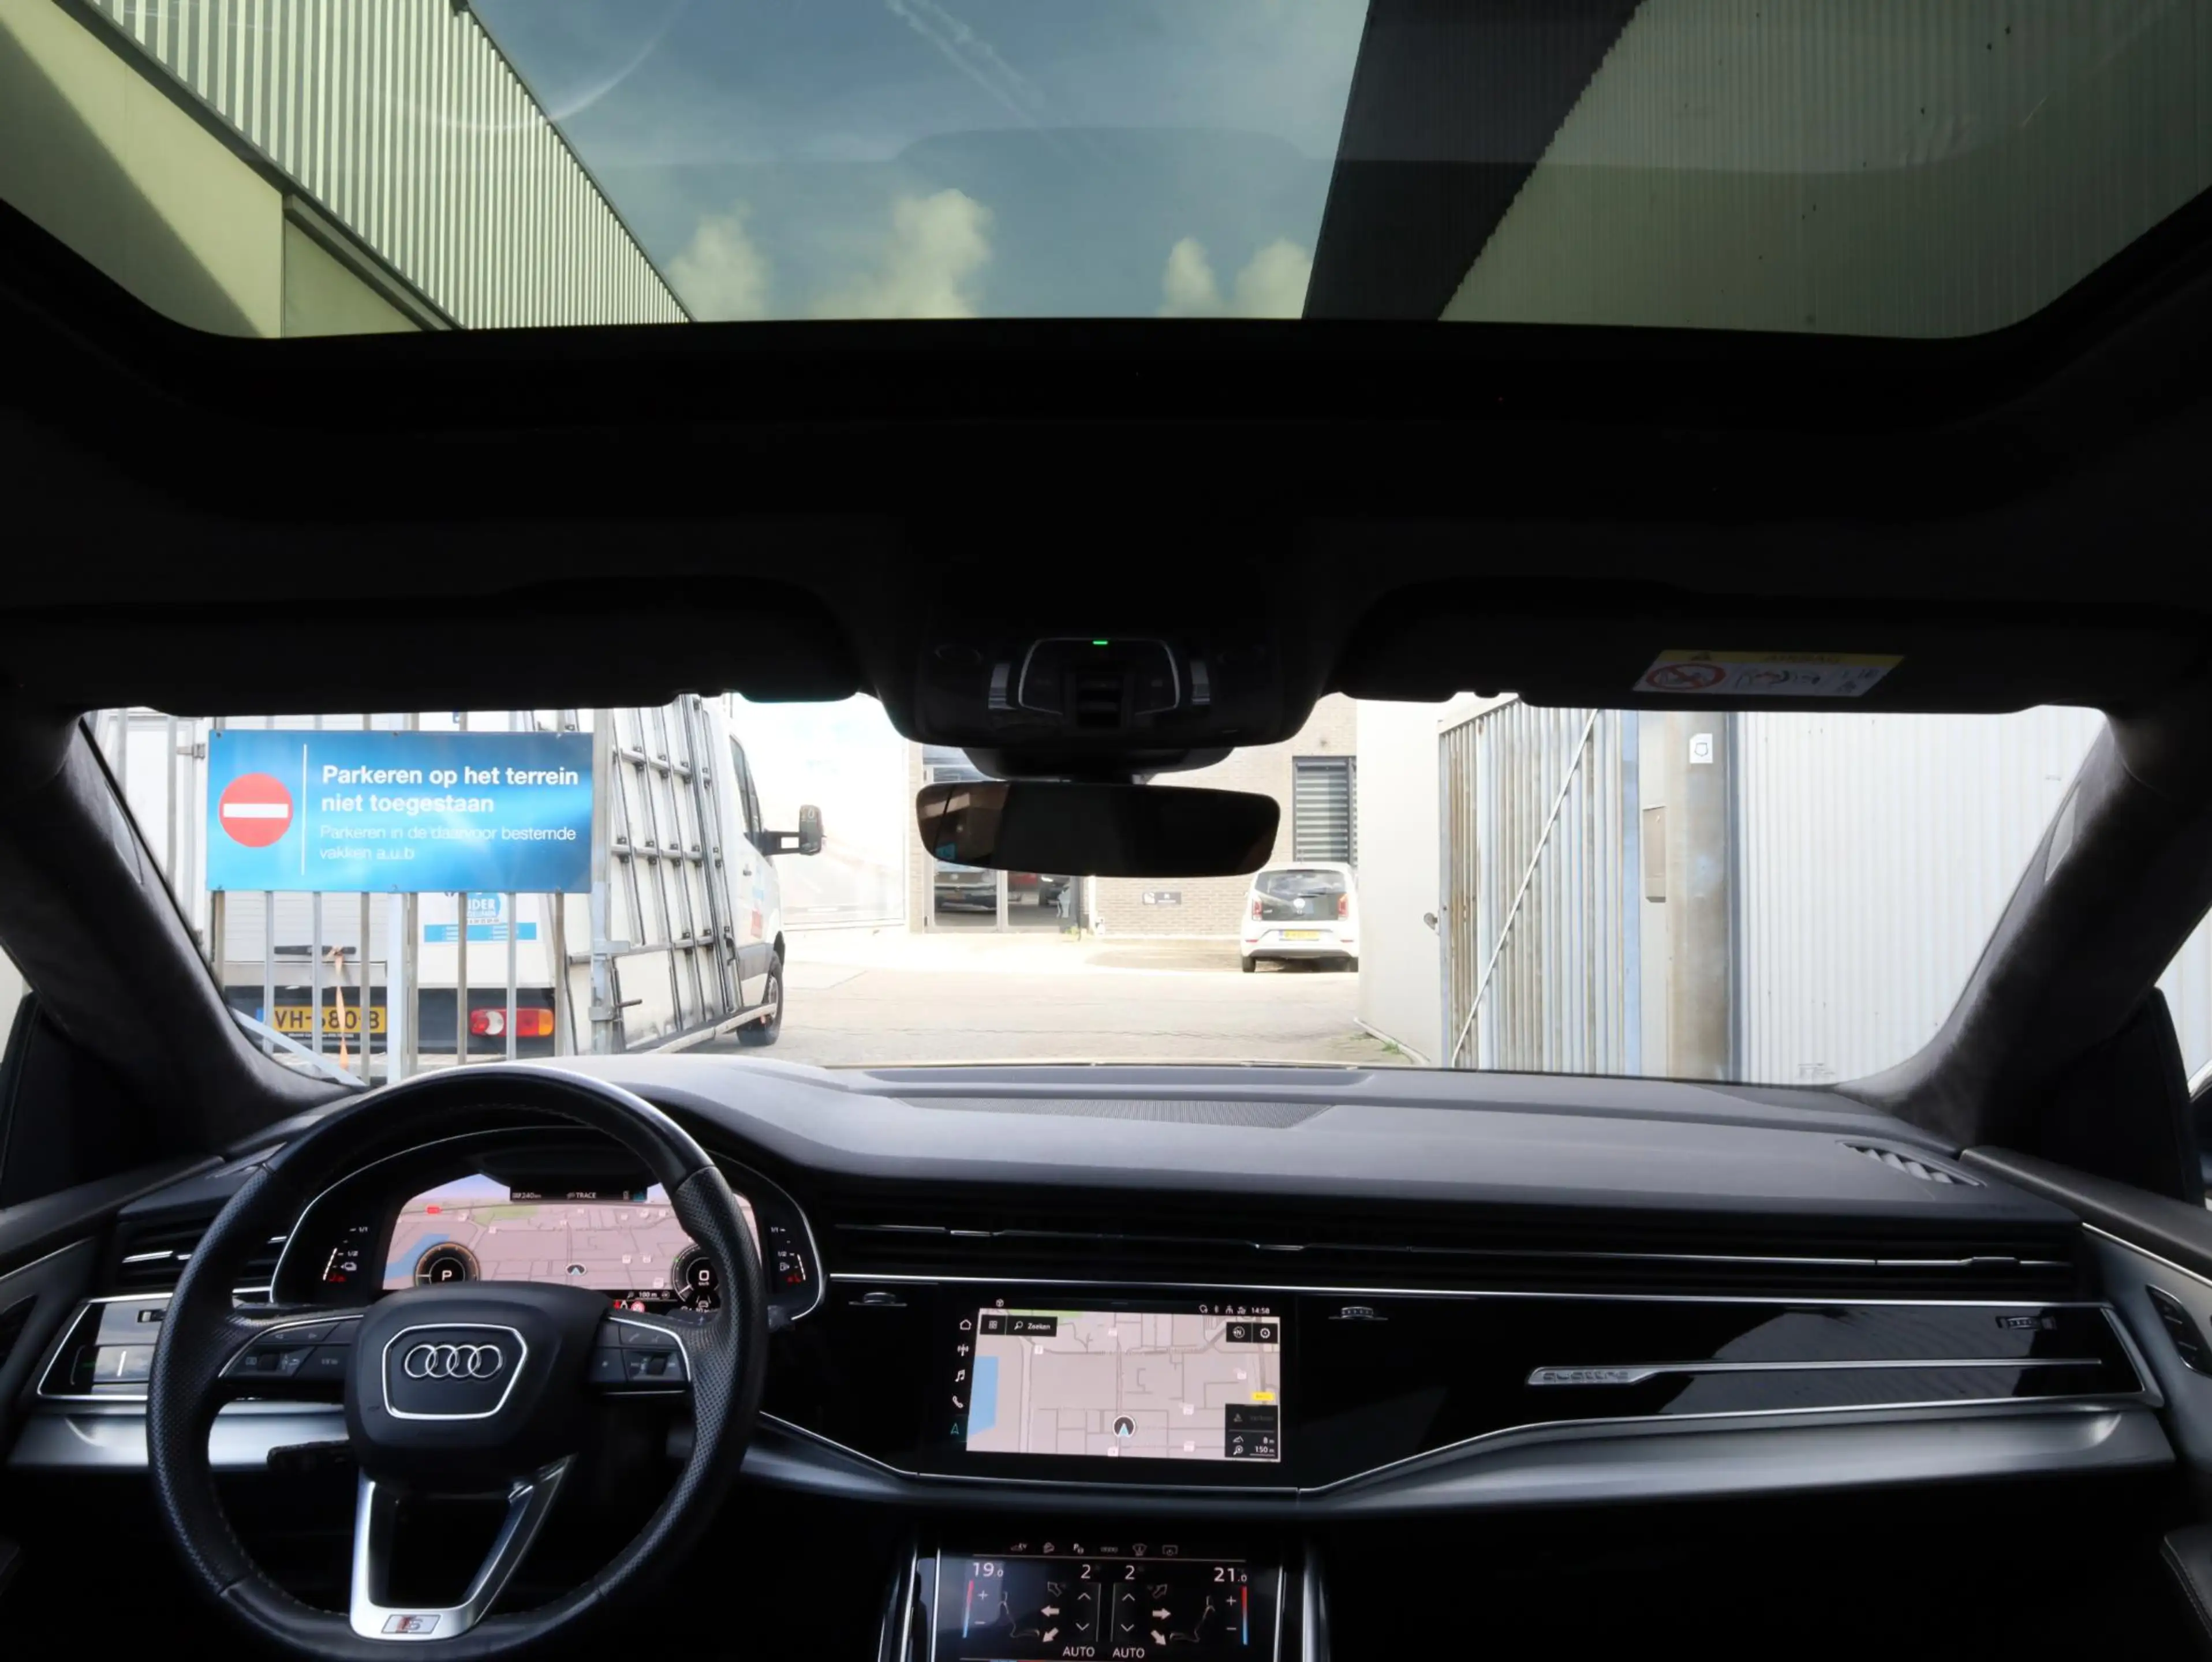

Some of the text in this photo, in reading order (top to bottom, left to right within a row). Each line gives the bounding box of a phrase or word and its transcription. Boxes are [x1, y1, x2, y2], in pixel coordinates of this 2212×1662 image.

[322, 765, 578, 789] Parkeren op het terrein
[322, 793, 494, 817] niet toegestaan
[320, 825, 577, 841] Parkeren in de daarvoor bestemde
[320, 846, 372, 860] vakken
[442, 1270, 453, 1281] P
[1080, 1564, 1091, 1579] 2
[1124, 1565, 1135, 1580] 2
[1213, 1566, 1247, 1582] 21.0
[1062, 1645, 1096, 1658] AUTO
[1112, 1647, 1145, 1659] AUTO
